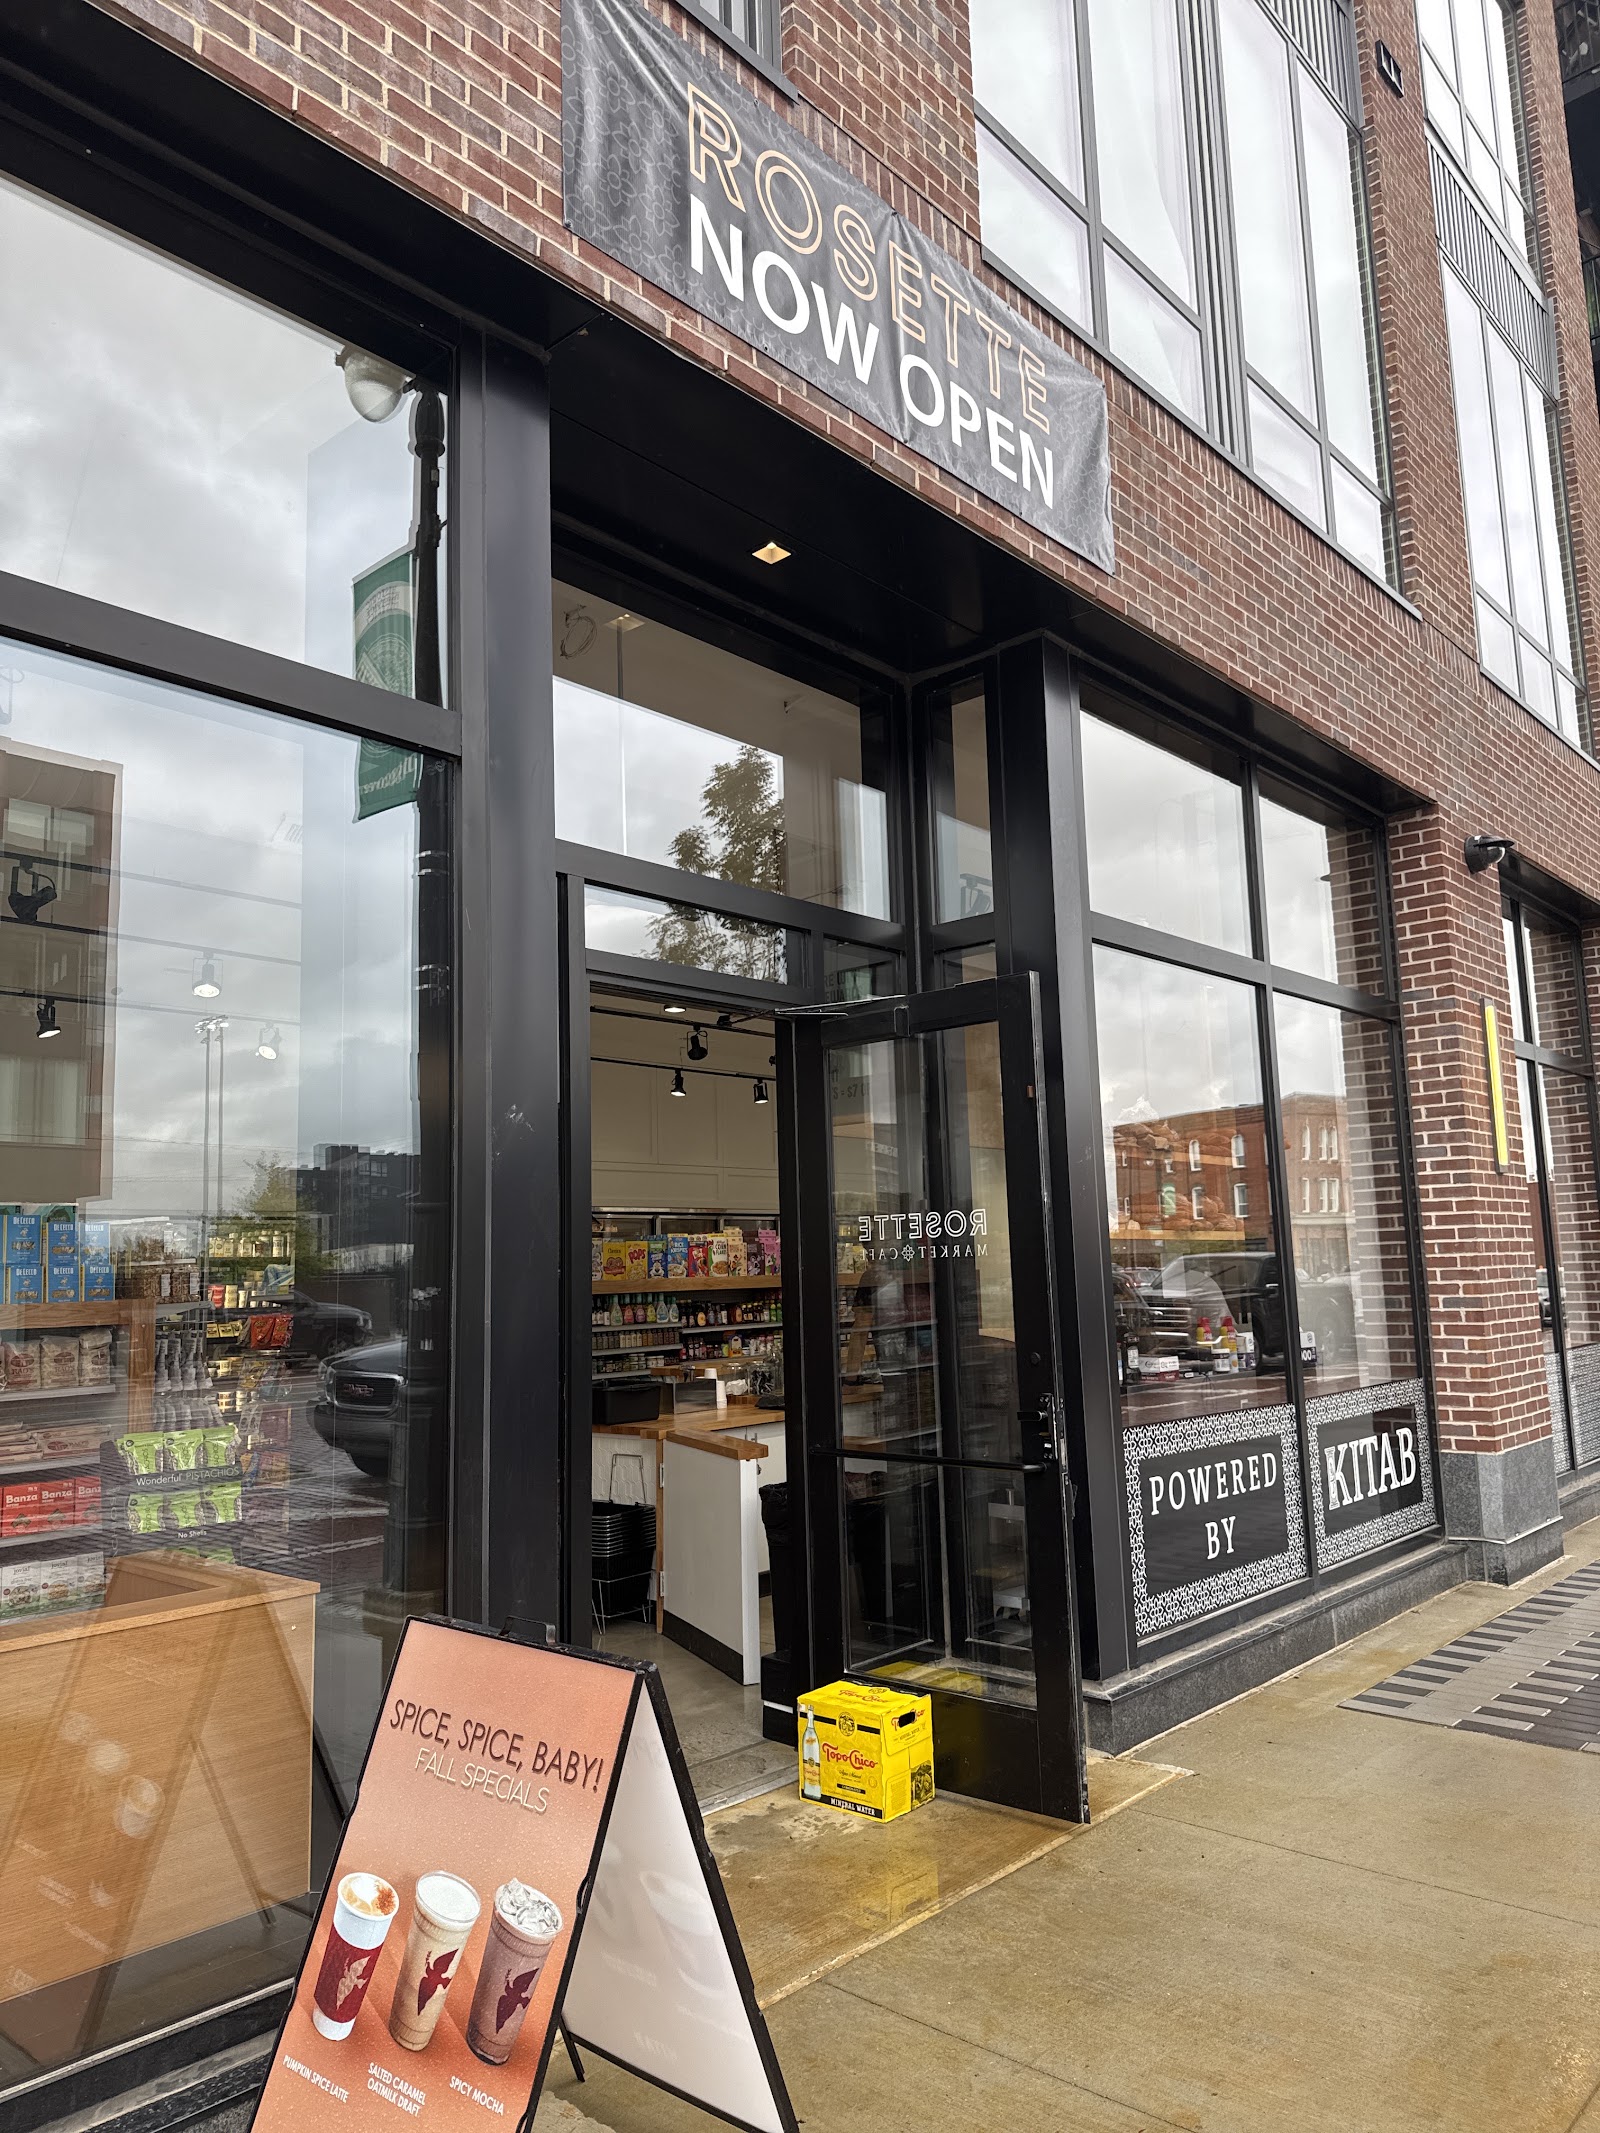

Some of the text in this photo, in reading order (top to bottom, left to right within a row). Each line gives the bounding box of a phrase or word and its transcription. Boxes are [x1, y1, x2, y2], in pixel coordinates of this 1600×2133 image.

[687, 82, 1050, 434] ROSETTE
[690, 193, 1053, 509] NOW OPEN
[136, 1467, 240, 1486] Wonderful PISTACHIOS
[1149, 1452, 1277, 1515] POWERED
[1324, 1427, 1417, 1511] KITAB
[5, 1494, 38, 1504] Banza
[41, 1489, 73, 1500] Banza
[1205, 1516, 1236, 1560] BY
[390, 1699, 604, 1794] SPICE, SPICE, BABY!
[822, 1742, 879, 1770] Topo Chico
[414, 1747, 550, 1813] FALL SPECIALS
[830, 1797, 876, 1816] MINERAL WATER
[282, 2054, 350, 2103] PUMPKIN SPICE LATTE
[367, 2077, 421, 2117] OATMILK DRAFT
[368, 2062, 426, 2106] SALTED CARAMEL
[449, 2075, 504, 2116] SPICY MOCHA
